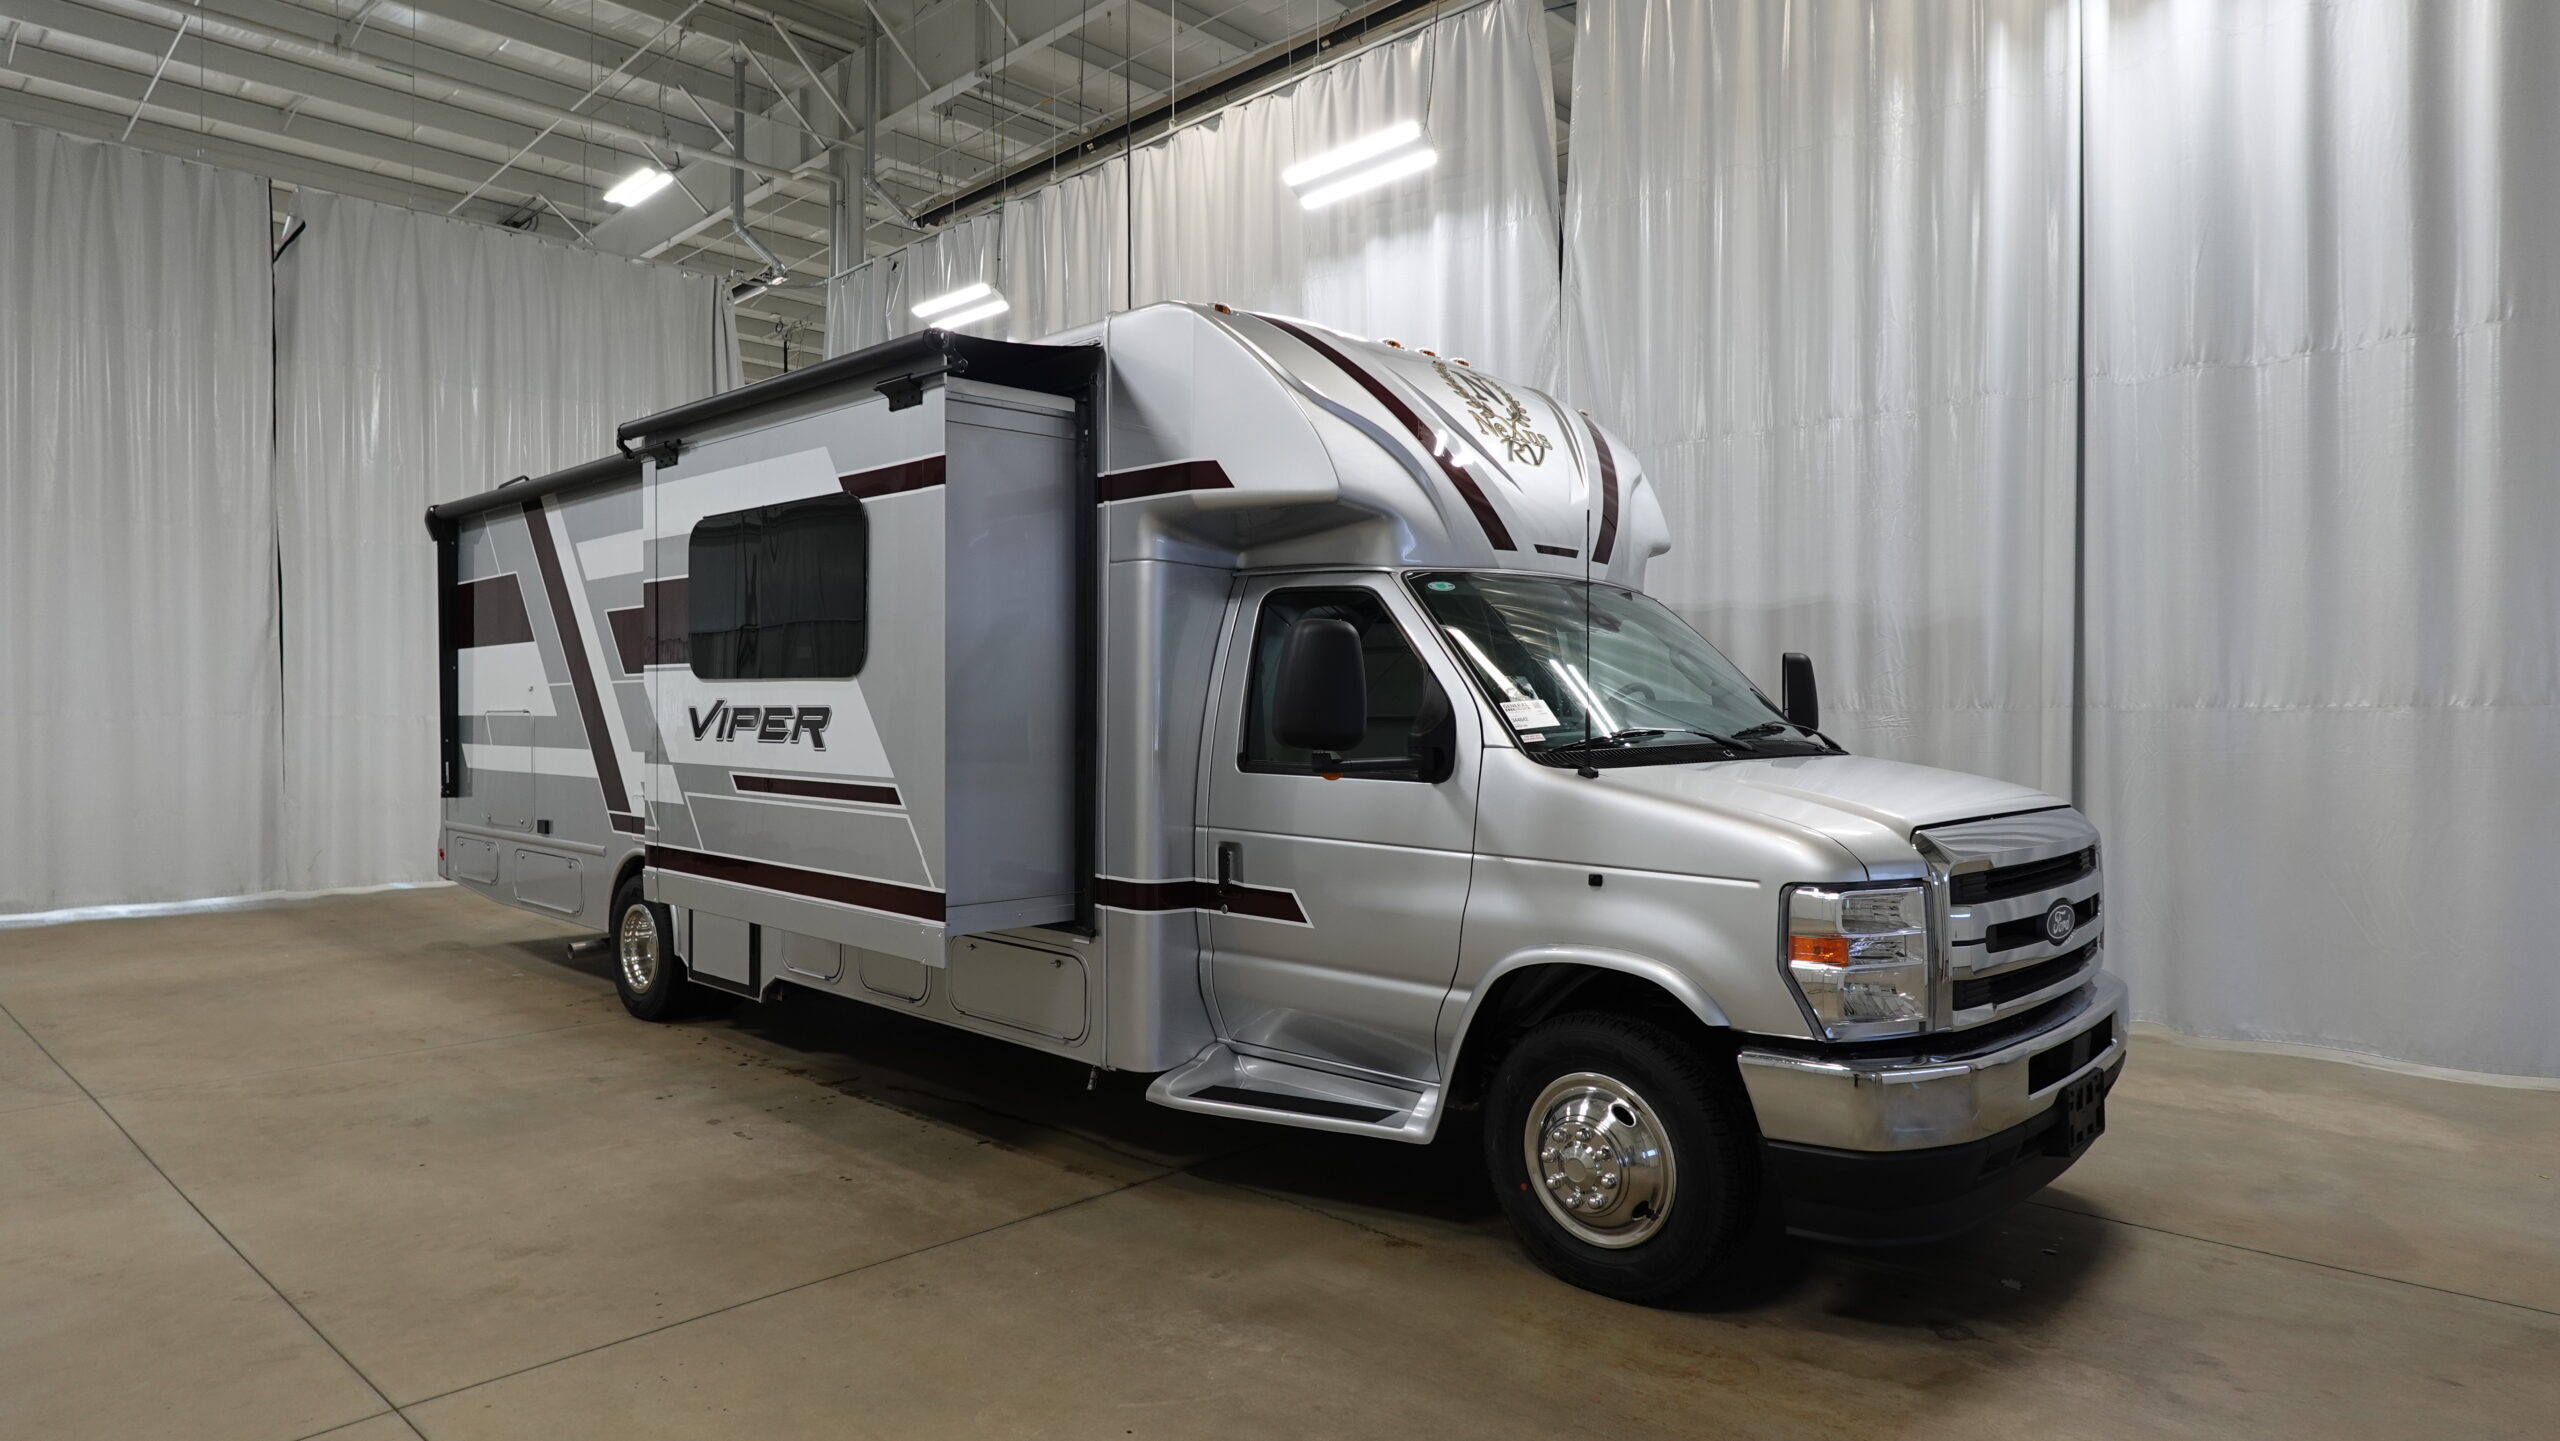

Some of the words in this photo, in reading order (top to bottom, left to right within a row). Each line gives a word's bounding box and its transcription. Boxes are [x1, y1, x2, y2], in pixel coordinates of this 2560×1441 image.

[1467, 409, 1553, 451] NeXus
[1500, 436, 1545, 466] RV
[688, 699, 832, 751] VIPER
[2053, 910, 2071, 934] Ford
